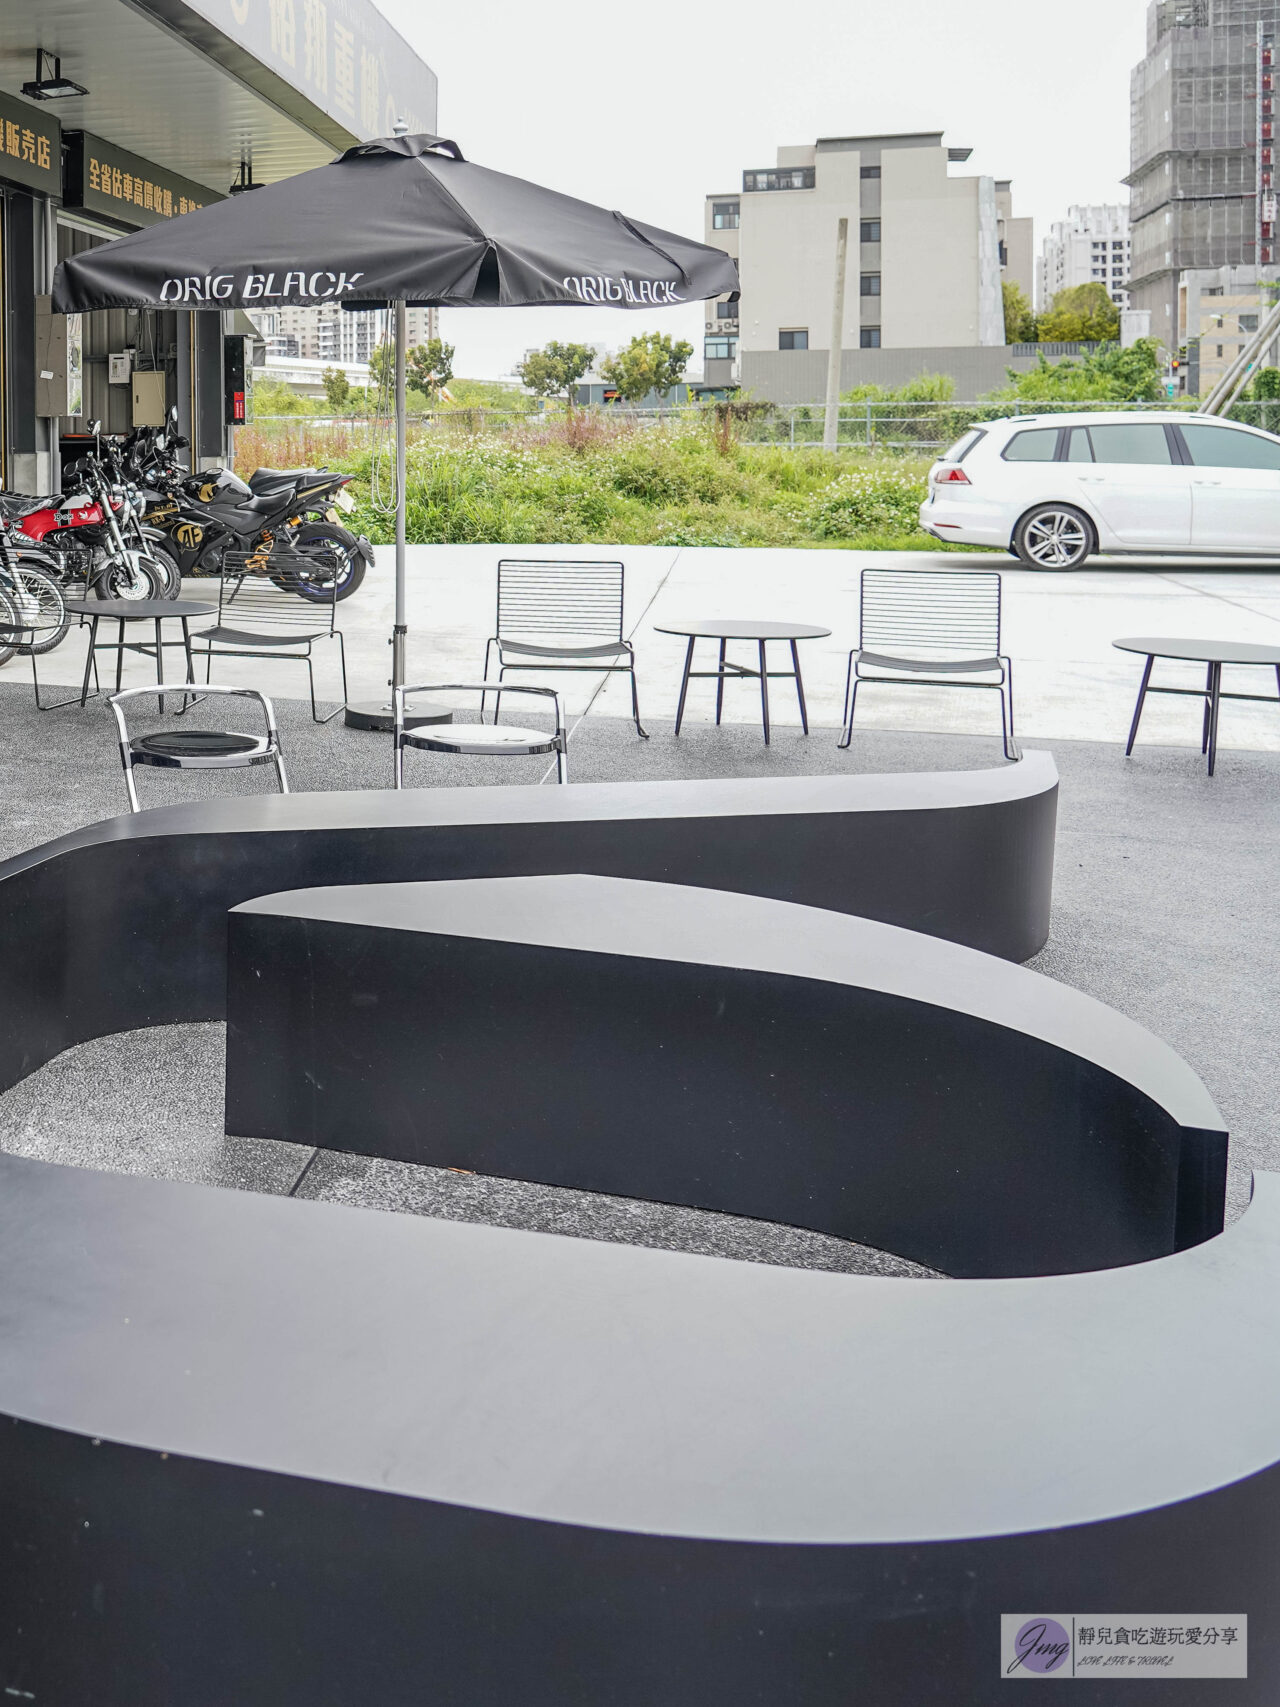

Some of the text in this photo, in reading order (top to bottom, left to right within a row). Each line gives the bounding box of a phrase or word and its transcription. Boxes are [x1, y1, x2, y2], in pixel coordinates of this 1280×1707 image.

[159, 271, 364, 302] ORIG BLACK
[563, 276, 621, 301] ORIG
